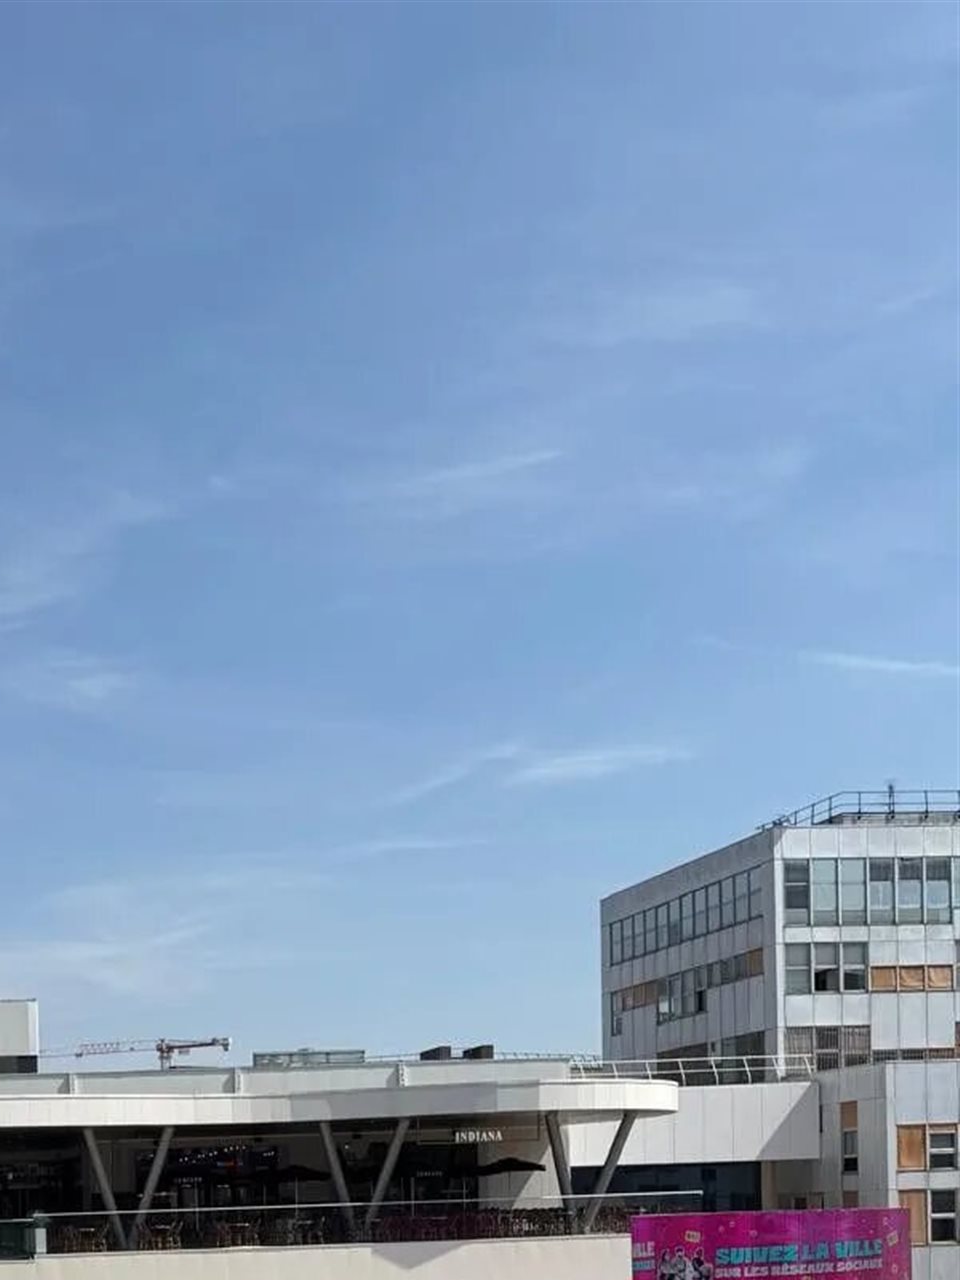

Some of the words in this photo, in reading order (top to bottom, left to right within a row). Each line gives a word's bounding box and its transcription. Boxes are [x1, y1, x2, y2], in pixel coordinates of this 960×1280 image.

[455, 1130, 503, 1143] INDIANA
[715, 1244, 798, 1265] SUIVEZ
[803, 1242, 830, 1261] LA
[835, 1239, 883, 1259] VILLE
[715, 1266, 741, 1279] SUR
[744, 1264, 768, 1277] LES
[837, 1258, 883, 1273] SOCIAUX
